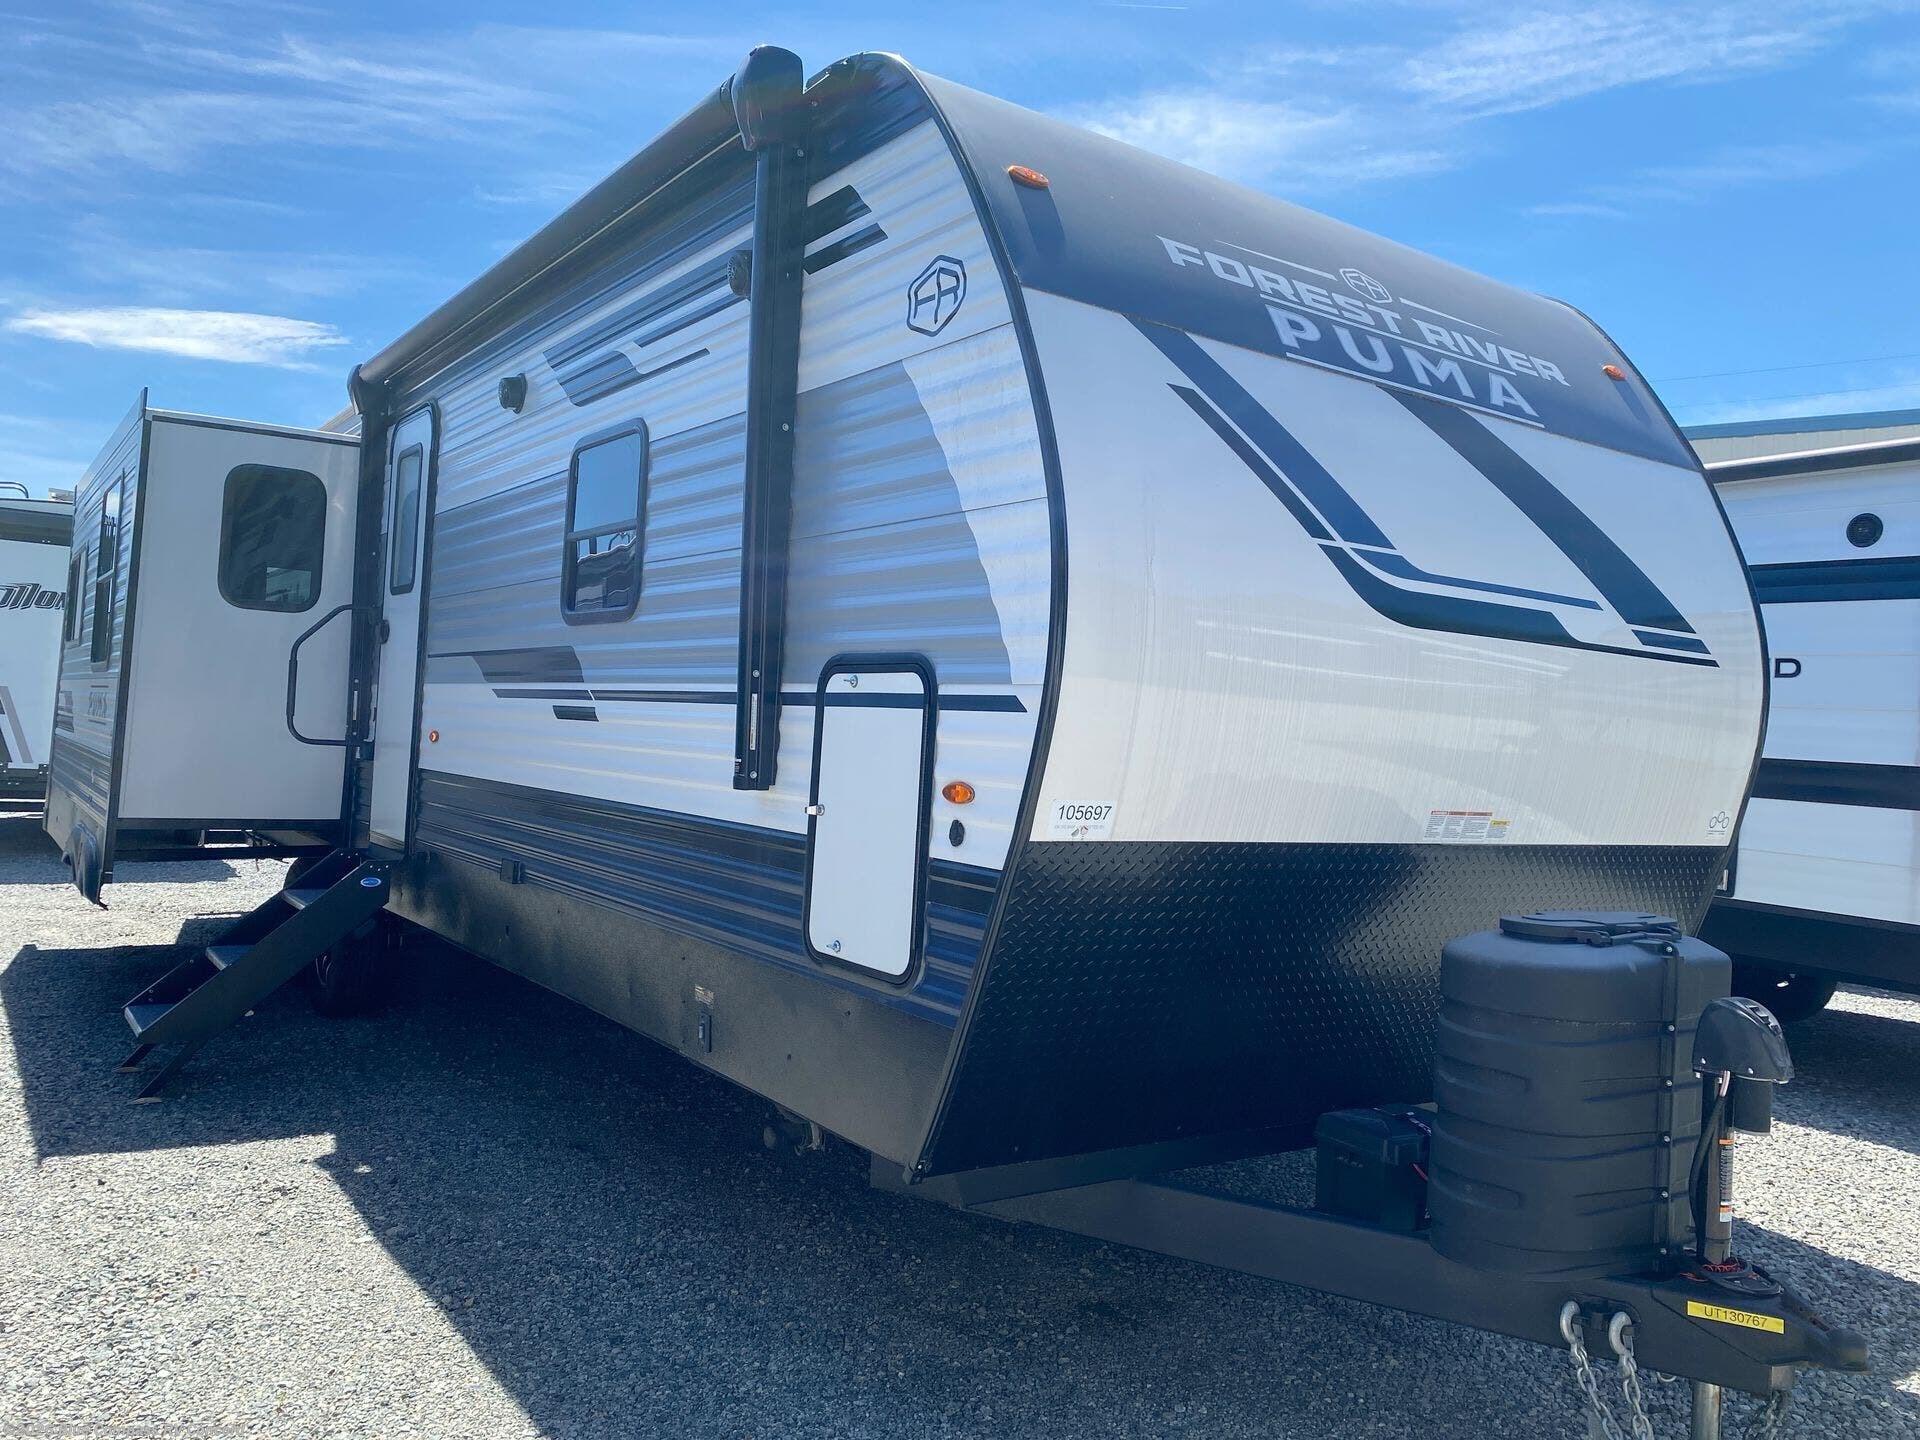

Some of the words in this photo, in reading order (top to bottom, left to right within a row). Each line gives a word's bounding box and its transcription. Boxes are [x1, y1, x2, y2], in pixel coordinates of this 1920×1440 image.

[1154, 234, 1402, 334] FOREST
[1410, 318, 1571, 387] RIVER
[1265, 303, 1539, 418] PUMA
[1058, 804, 1112, 821] 105697
[1704, 1305, 1768, 1328] UT130767
